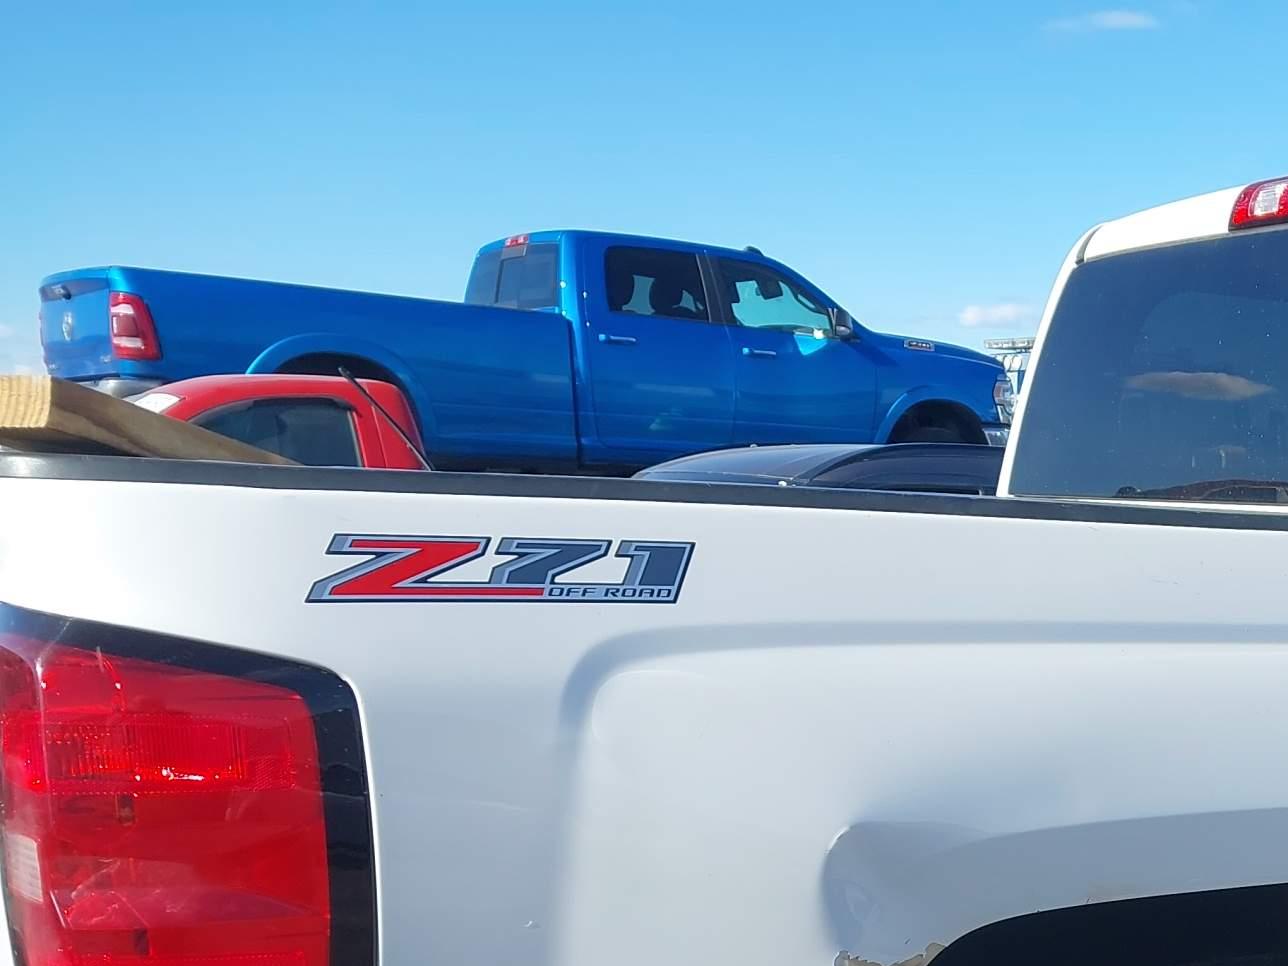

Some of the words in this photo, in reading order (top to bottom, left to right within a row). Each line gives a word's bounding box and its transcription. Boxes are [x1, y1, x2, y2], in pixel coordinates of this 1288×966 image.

[305, 533, 697, 604] Z71
[547, 586, 600, 599] OFF
[603, 586, 674, 599] ROAD
